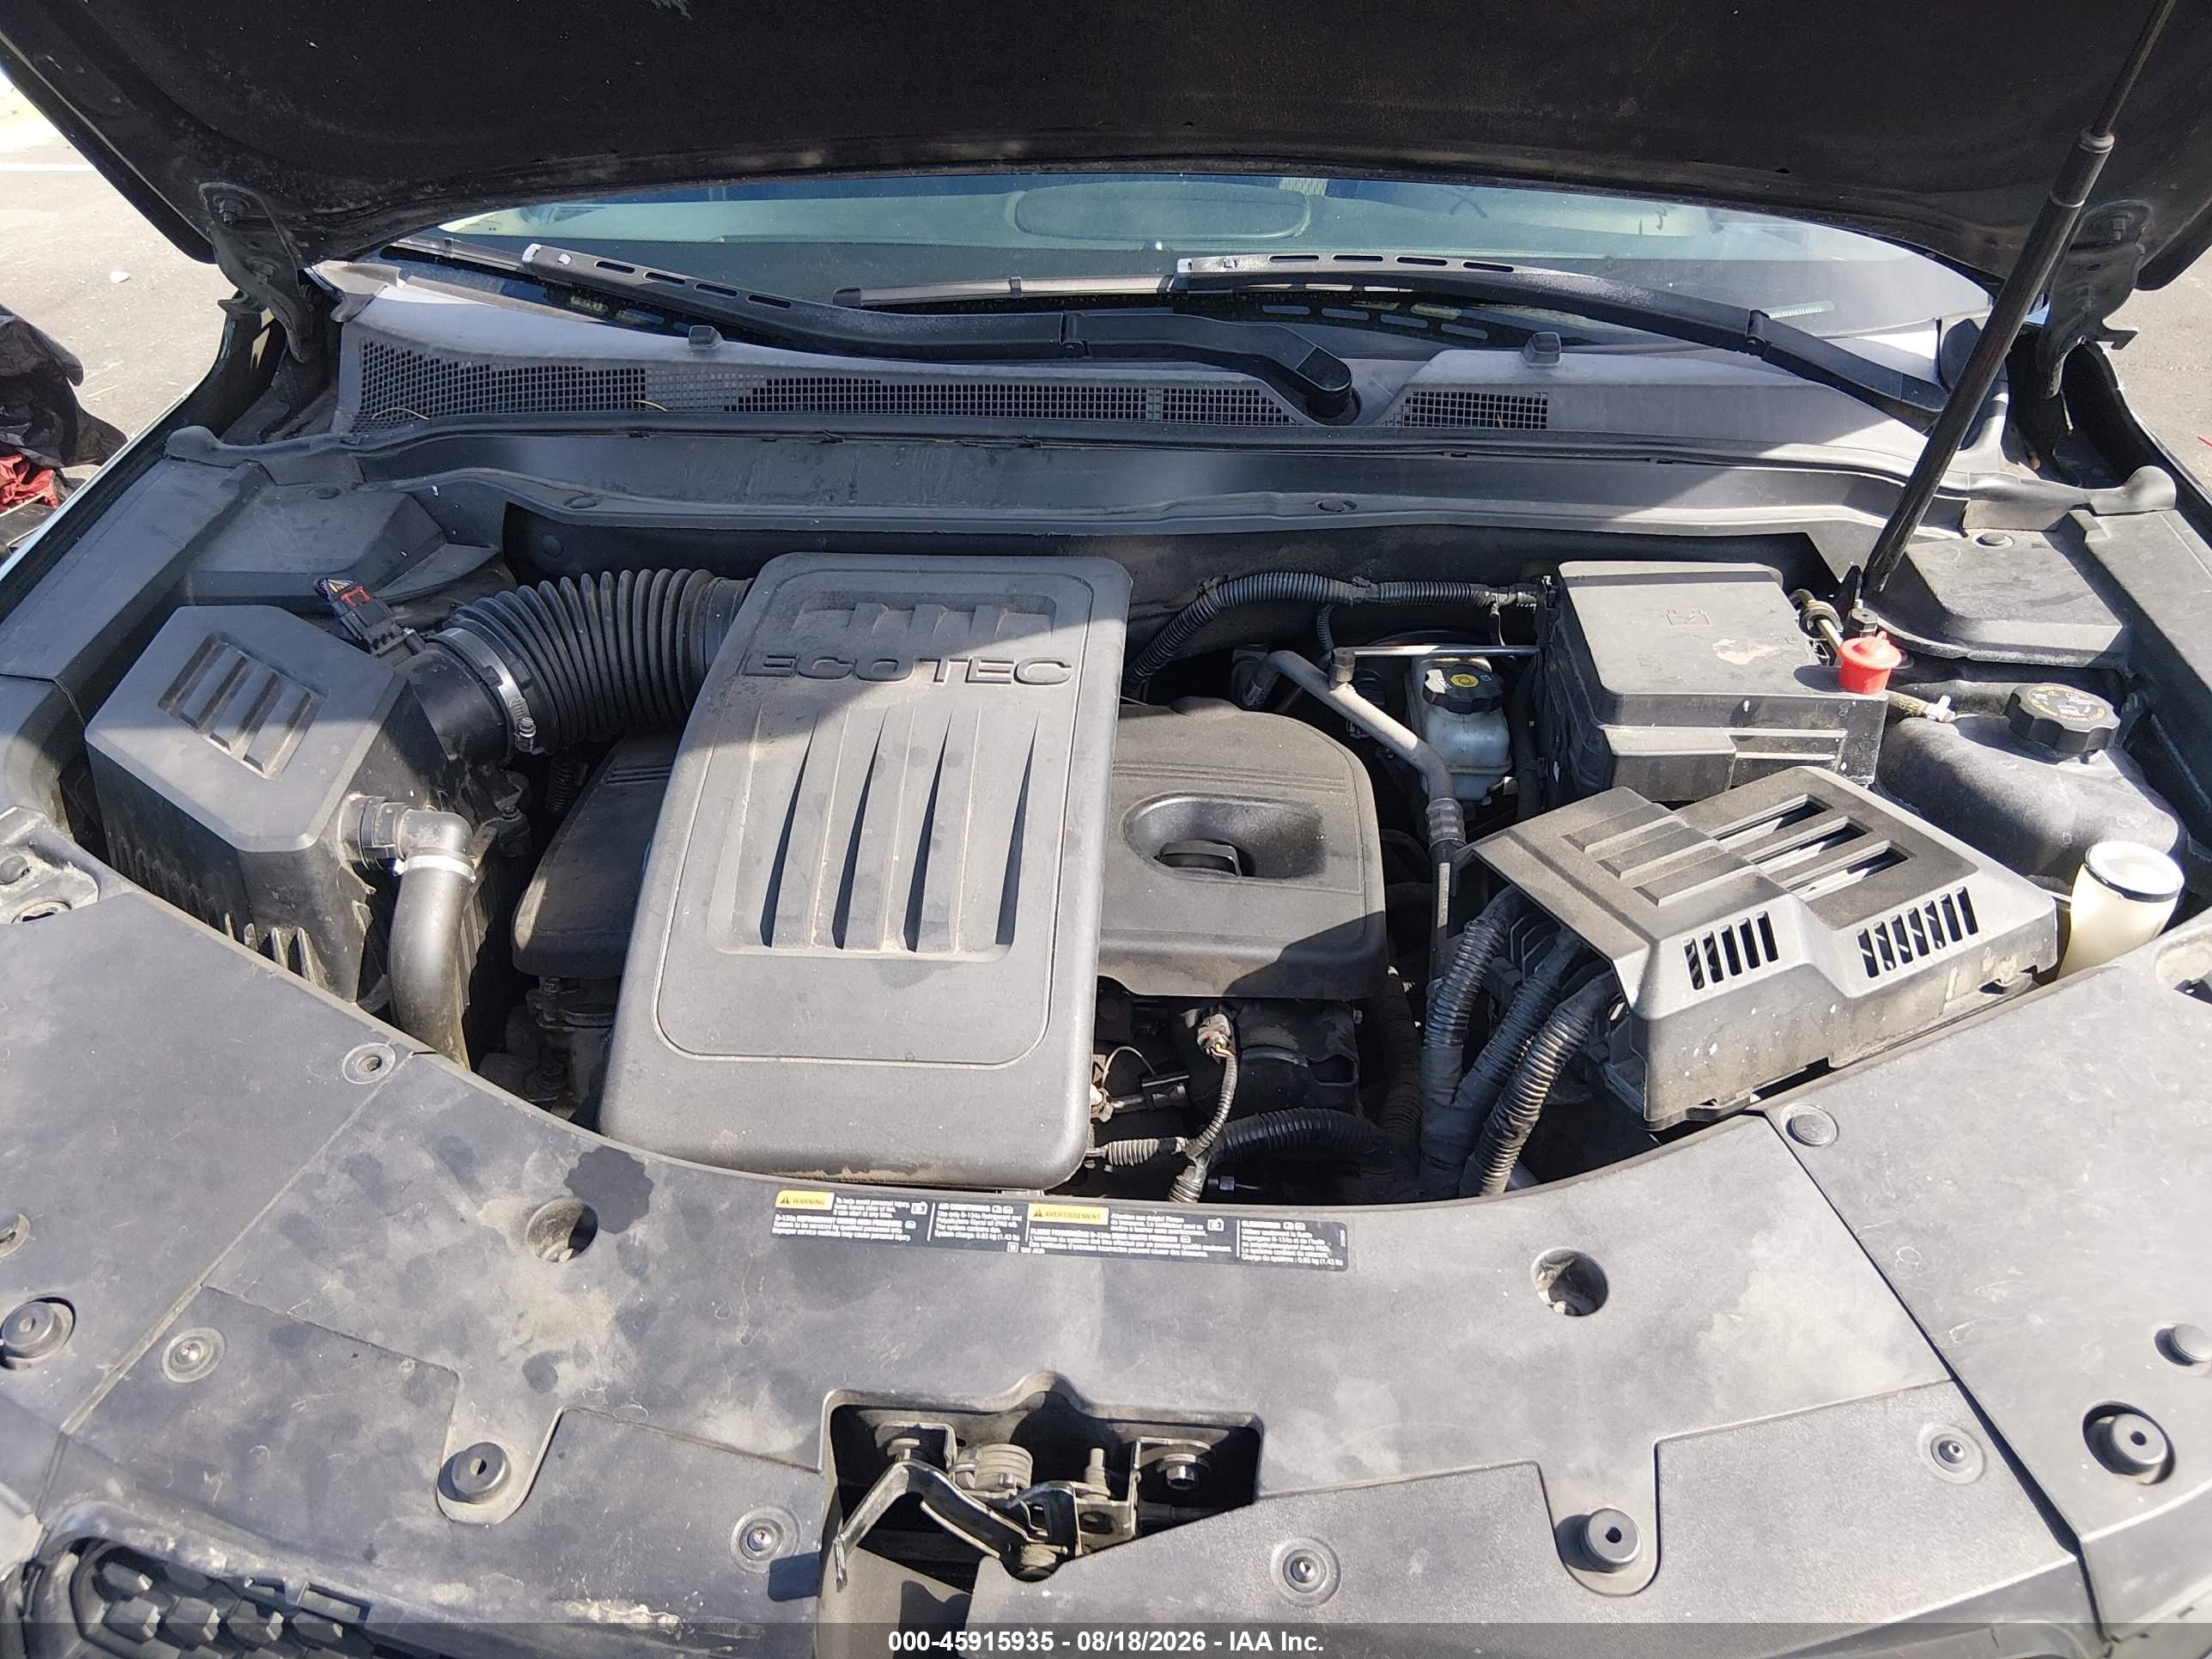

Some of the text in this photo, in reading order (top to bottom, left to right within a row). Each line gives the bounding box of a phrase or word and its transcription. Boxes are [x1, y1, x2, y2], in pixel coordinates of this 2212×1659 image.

[736, 653, 1073, 686] ECOTEC
[793, 1197, 825, 1206] WARNING
[1044, 1211, 1100, 1220] AVERTISSEMENT
